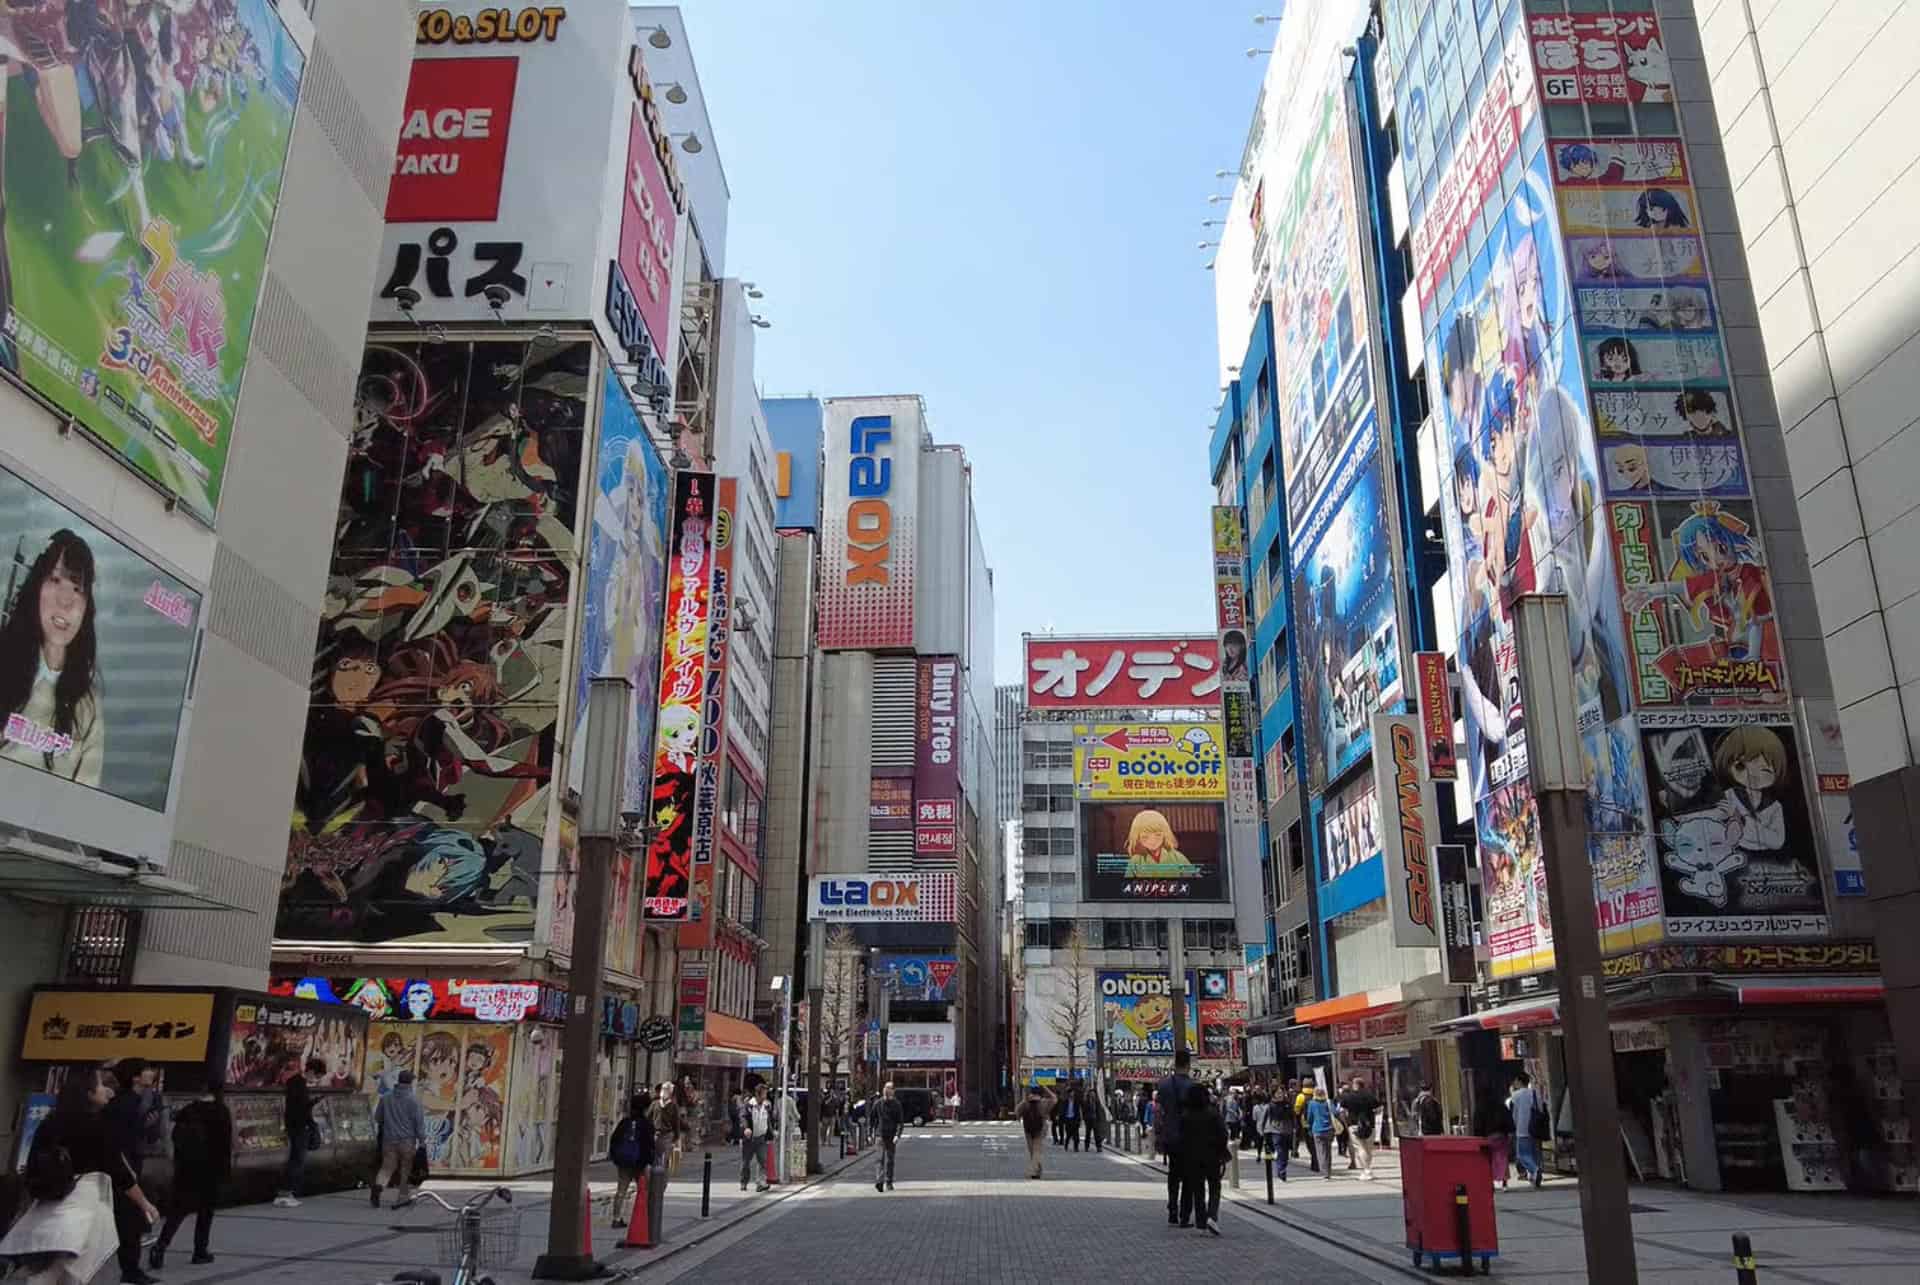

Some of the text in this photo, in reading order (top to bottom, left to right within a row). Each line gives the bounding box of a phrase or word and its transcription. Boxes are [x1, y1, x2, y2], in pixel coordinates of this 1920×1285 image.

[1531, 17, 1655, 37] ホビーランド
[1535, 35, 1622, 71] ぽち
[1546, 79, 1576, 96] 6F
[379, 227, 528, 300] パス
[105, 326, 153, 378] 3rd
[150, 364, 220, 441] Anniversary
[1031, 640, 1222, 698] オノデン
[702, 667, 723, 757] ZOO
[930, 662, 956, 765] Duty Free
[1123, 776, 1219, 790] 現在地から徒歩4分
[920, 803, 952, 820] 免税
[1390, 722, 1436, 937] GAMERS
[1123, 881, 1190, 894] ANIPLEX
[818, 907, 920, 919] Home Electronics Store
[1102, 978, 1190, 996] ONODE
[111, 1020, 196, 1039] ライオン
